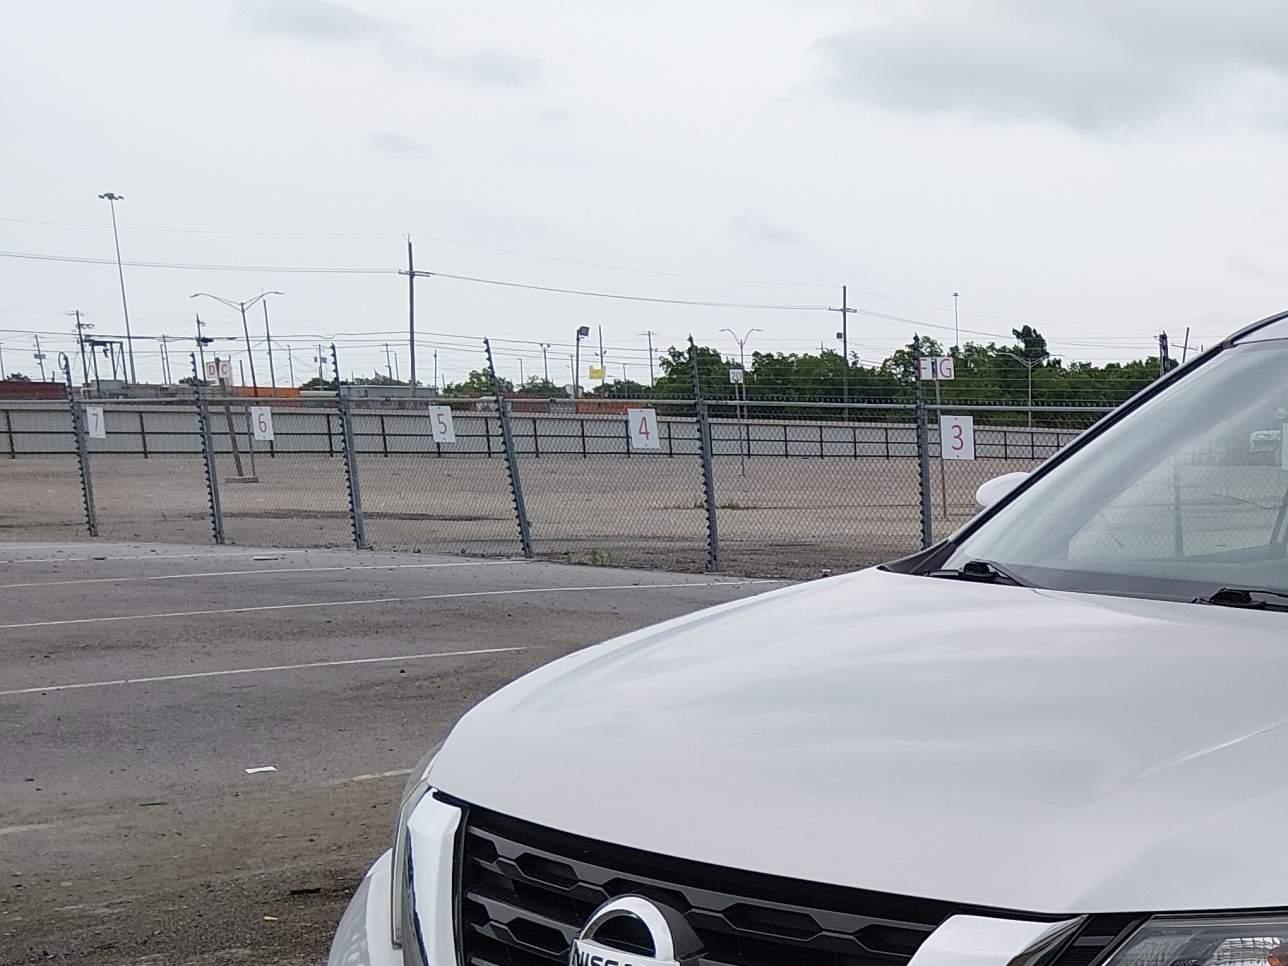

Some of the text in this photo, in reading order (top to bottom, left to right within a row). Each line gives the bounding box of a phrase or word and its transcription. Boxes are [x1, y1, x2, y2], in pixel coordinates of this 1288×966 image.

[208, 364, 216, 376] D
[221, 363, 229, 375] C
[940, 358, 953, 379] G
[91, 413, 99, 432] 7
[258, 412, 267, 433] 6
[437, 413, 447, 435] 5
[638, 416, 650, 440] 4
[951, 424, 964, 451] 3
